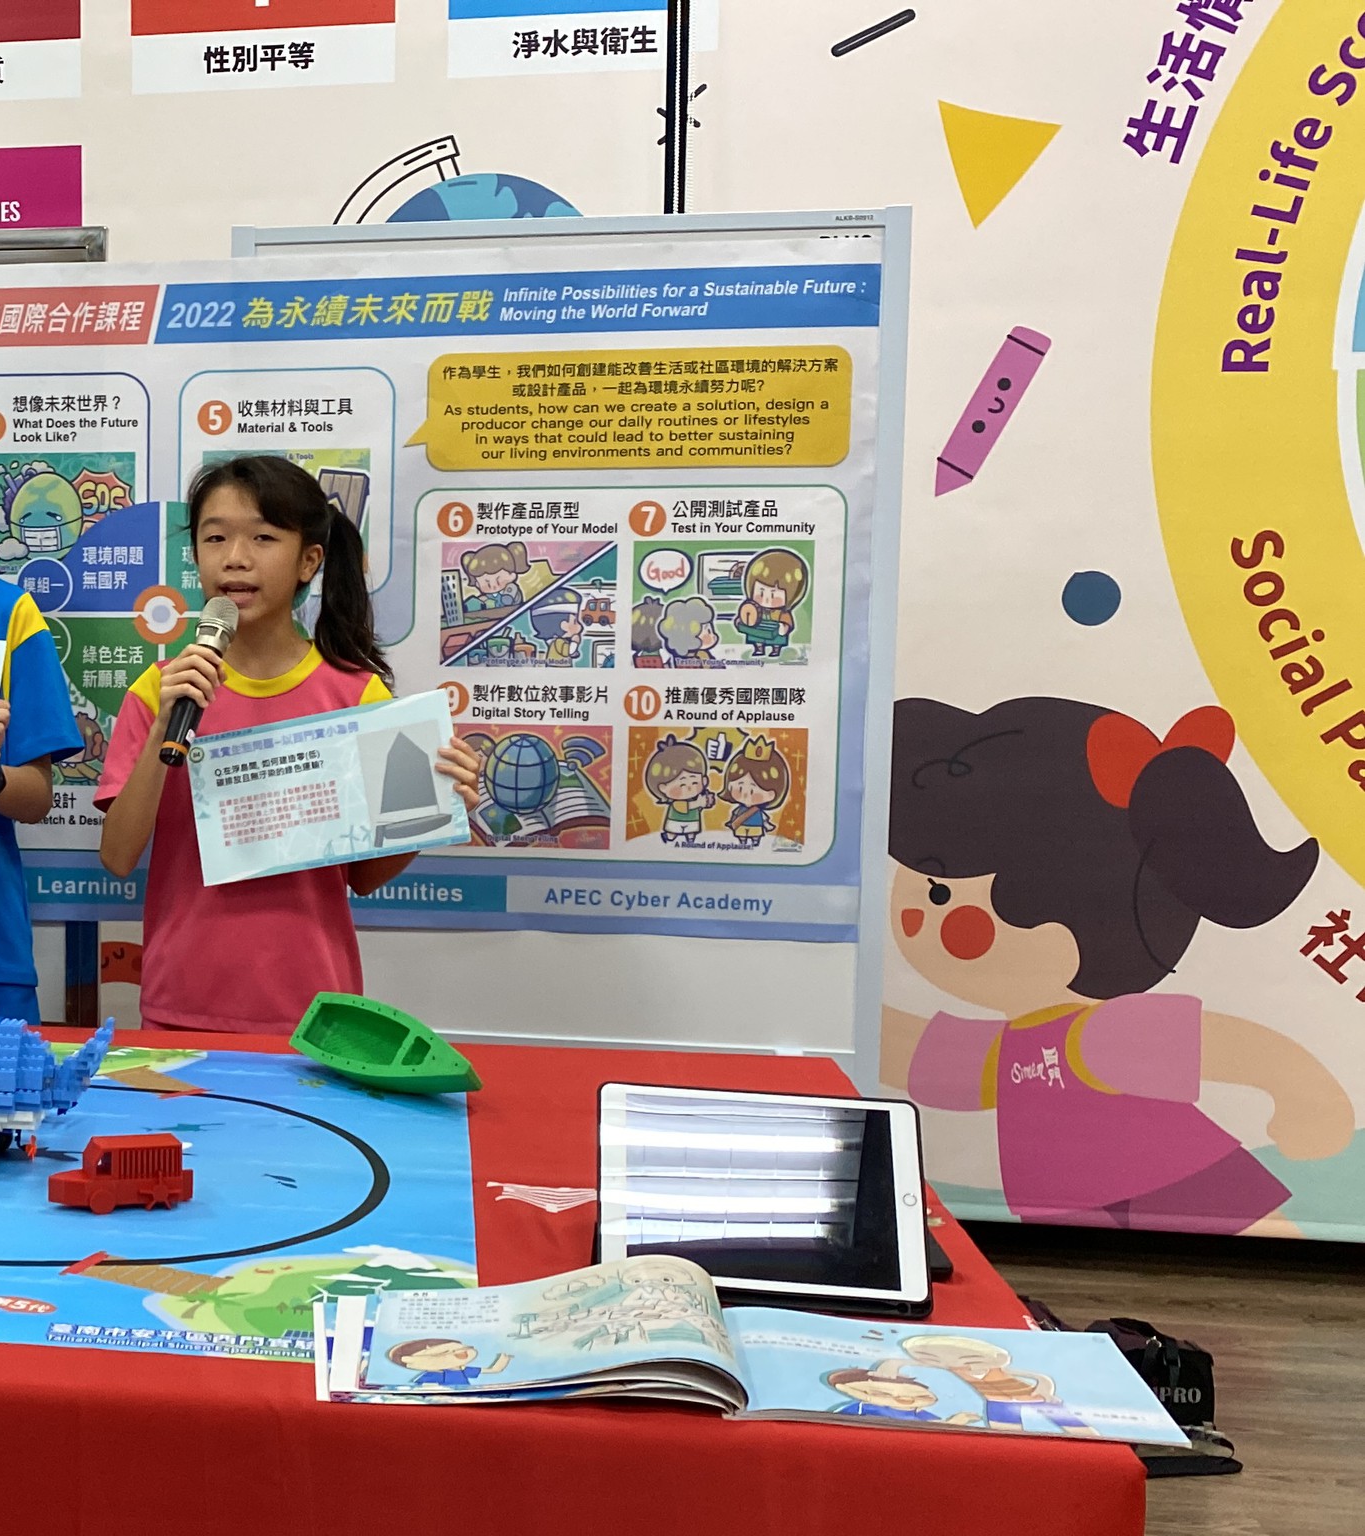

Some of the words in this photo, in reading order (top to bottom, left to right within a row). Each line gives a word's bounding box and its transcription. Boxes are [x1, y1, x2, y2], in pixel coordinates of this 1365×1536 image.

[512, 25, 658, 59] 淨水與衛生
[203, 42, 316, 75] 性別平等
[1221, 117, 1333, 373] Real-Life
[503, 287, 557, 302] Infinite
[561, 284, 658, 301] Possibilities
[662, 284, 686, 298] for
[689, 286, 698, 297] a
[703, 281, 798, 297] Sustainable
[802, 280, 857, 295] Future
[166, 302, 236, 329] 2022
[242, 289, 494, 329] 為永續未來而戰
[499, 307, 556, 324] Moving
[561, 306, 586, 321] the
[590, 304, 637, 319] World
[641, 302, 708, 318] Forward
[237, 398, 353, 417] 收集材料與工具
[444, 404, 462, 415] As
[467, 403, 533, 416] students,
[538, 402, 568, 413] how
[573, 403, 599, 413] can
[604, 403, 625, 412] we
[631, 401, 677, 411] create
[682, 401, 691, 411] a
[696, 399, 760, 412] solution,
[765, 398, 815, 413] design
[820, 400, 829, 409] a
[13, 418, 42, 429] What
[46, 418, 76, 429] Does
[79, 417, 97, 428] the
[101, 417, 138, 428] Future
[208, 405, 222, 430] 5
[461, 419, 526, 433] producor
[531, 417, 584, 431] change
[589, 418, 613, 427] our
[657, 414, 718, 427] routines
[723, 416, 739, 426] or
[744, 414, 810, 428] lifestyles
[13, 431, 42, 442] Look
[45, 431, 77, 442] Like?
[237, 422, 285, 433] Material
[288, 422, 297, 433] &
[301, 422, 334, 432] Tools
[475, 433, 487, 444] in
[493, 434, 529, 447] ways
[534, 432, 562, 443] that
[568, 431, 607, 443] could
[613, 430, 644, 442] lead
[649, 431, 664, 442] to
[669, 430, 713, 441] better
[718, 429, 795, 443] sustaining
[481, 450, 505, 459] our
[510, 448, 547, 461] living
[552, 446, 650, 458] environments
[655, 445, 683, 456] and
[688, 443, 792, 456] communities?
[476, 501, 579, 520] 製作產品原型
[641, 505, 657, 533] 7
[672, 500, 778, 519] 公開測試產品
[448, 506, 464, 533] 6
[671, 522, 696, 533] Test
[700, 522, 711, 533] in
[716, 522, 744, 533] Your
[746, 522, 816, 536] Community
[476, 523, 534, 537] Prototype
[536, 523, 550, 534] of
[551, 523, 579, 534] Your
[582, 523, 618, 534] Model
[82, 546, 144, 566] 環境問題
[82, 571, 128, 590] 無國界
[646, 562, 685, 581] Good
[1231, 529, 1353, 717] Social
[82, 646, 144, 665] 綠色生活
[82, 670, 129, 688] 新願景
[628, 690, 651, 715] 10
[665, 687, 806, 706] 推薦優秀國際團隊
[472, 707, 510, 720] Digital
[513, 708, 546, 721] Story
[549, 708, 589, 721] Telling
[664, 710, 674, 720] A
[676, 709, 717, 721] Round
[721, 710, 734, 721] of
[736, 710, 795, 724] Applause
[68, 815, 76, 825] &
[37, 876, 136, 899] Learning
[544, 888, 602, 905] APEC
[610, 890, 669, 911] Cyber
[676, 892, 773, 915] Academy
